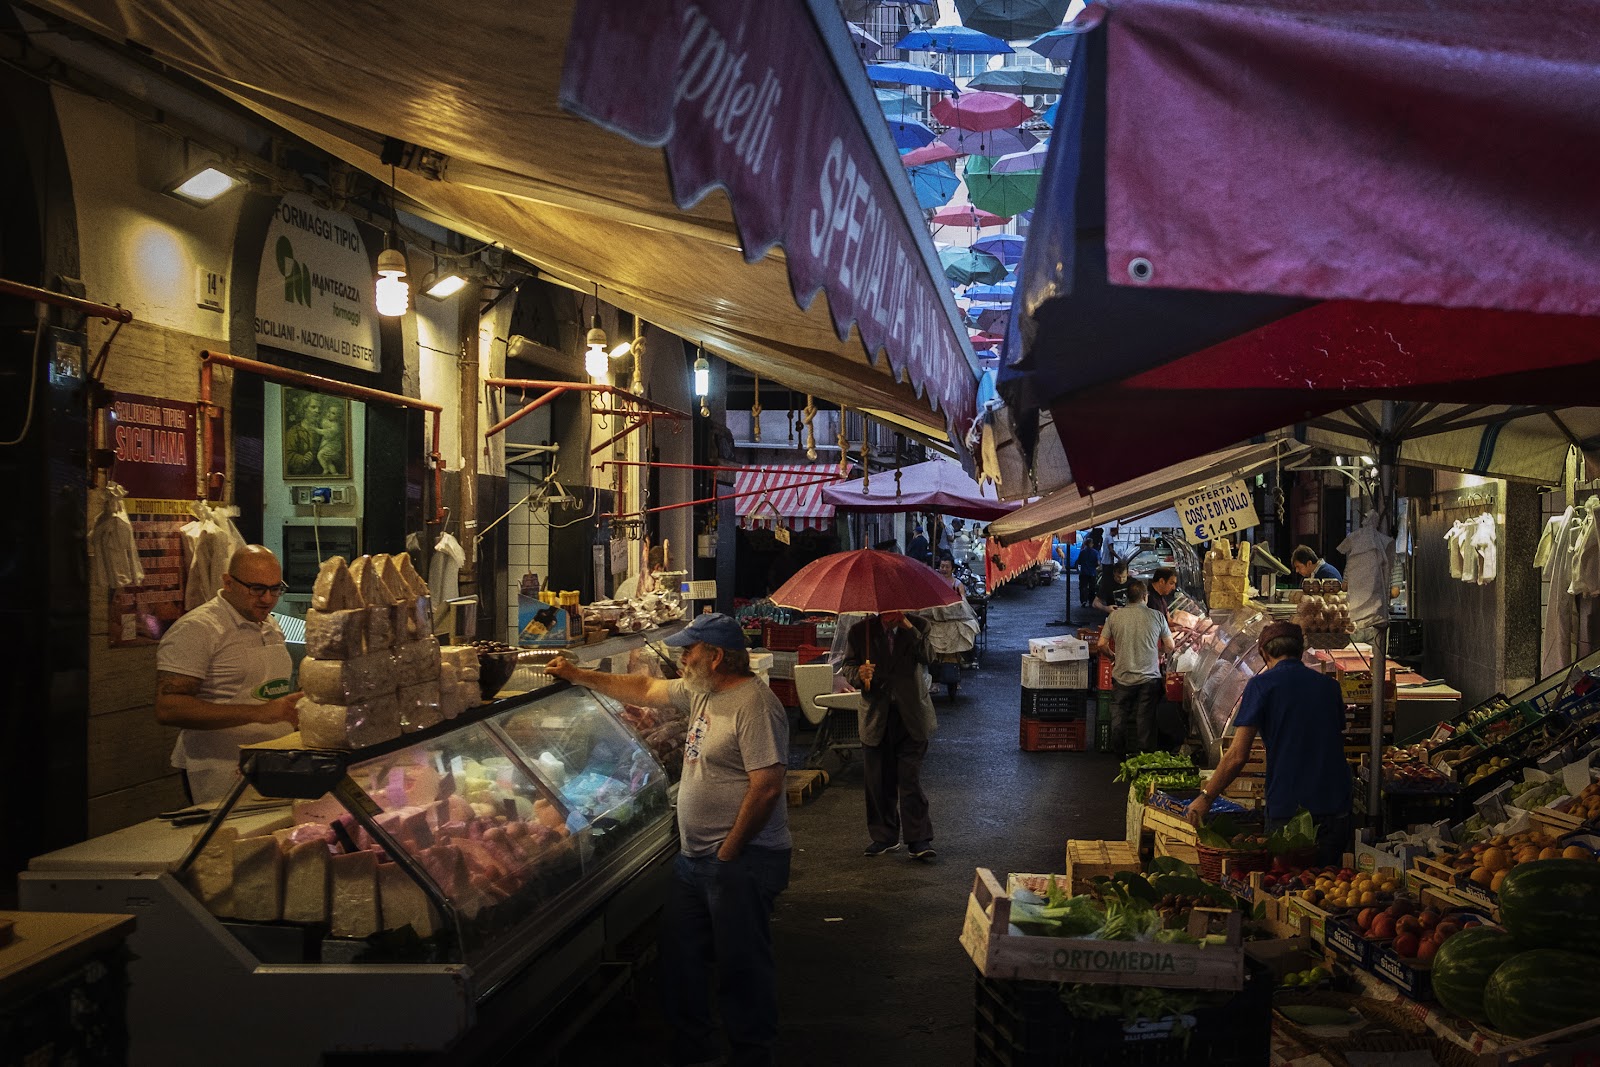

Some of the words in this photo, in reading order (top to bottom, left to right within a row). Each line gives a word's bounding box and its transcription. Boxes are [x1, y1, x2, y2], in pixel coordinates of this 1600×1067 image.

[273, 203, 333, 242] FORMAGGI
[334, 224, 361, 254] TIPICI
[312, 273, 361, 303] MANTEGAZZA
[332, 301, 361, 327] formaggi
[254, 316, 297, 339] SICILIANI
[301, 332, 341, 353] NAZIONALI
[342, 342, 352, 357] ED
[352, 344, 375, 363] ESTERI
[115, 401, 162, 426] SALUMERIA
[162, 406, 187, 430] TIPICA
[116, 425, 187, 466] SICILIANA
[135, 500, 162, 514] PRODOTTI
[163, 500, 179, 514] TIPICI
[1188, 485, 1233, 506] OFFERTA
[1213, 500, 1224, 516] DI
[1222, 492, 1249, 513] POLLO
[1333, 930, 1356, 951] Sicilia
[1053, 948, 1175, 973] ORTOMEDIA
[1380, 957, 1404, 980] Sicilia
